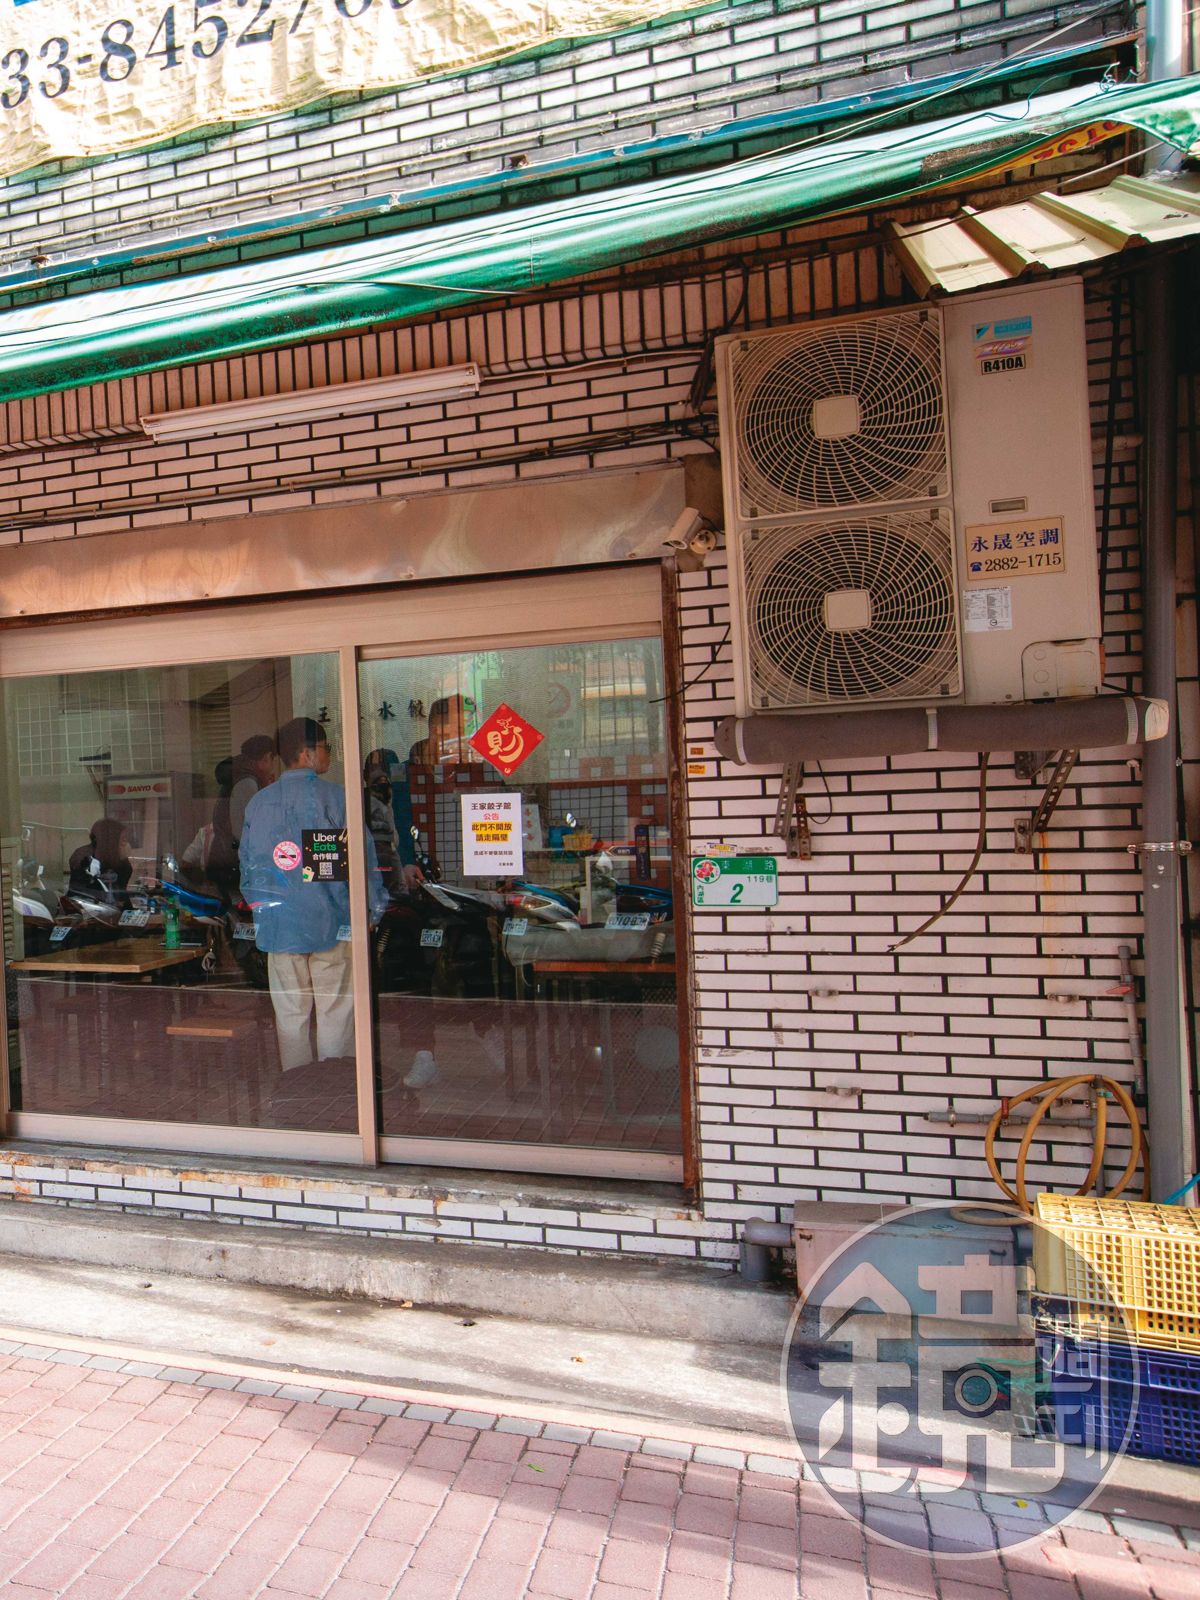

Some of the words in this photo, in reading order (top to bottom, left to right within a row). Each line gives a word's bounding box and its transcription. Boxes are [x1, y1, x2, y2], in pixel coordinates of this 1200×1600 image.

[983, 356, 1023, 372] R410A
[970, 527, 1059, 552] 永晟空調
[984, 552, 1062, 572] 2882-1715
[471, 823, 513, 831] 此門不開放
[312, 832, 337, 842] Uber
[313, 842, 337, 852] Eats
[312, 852, 339, 861] 合作餐廳
[729, 883, 745, 903] 2
